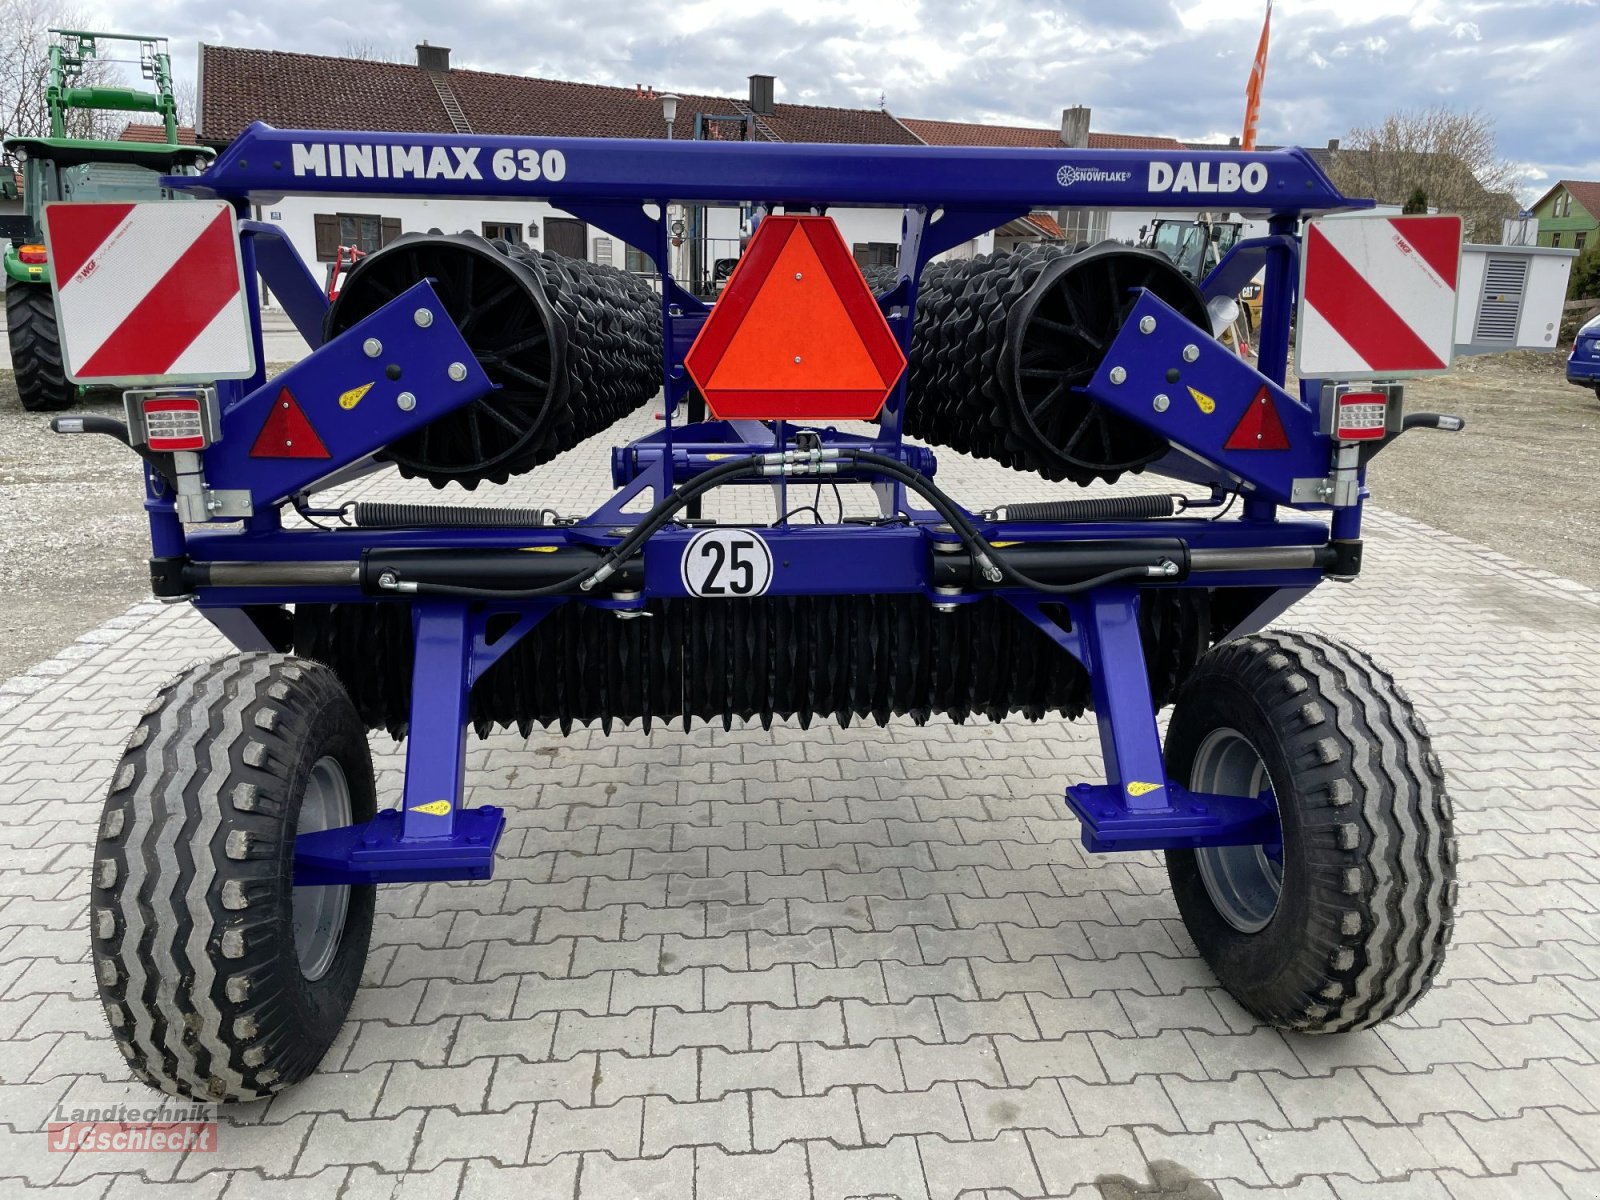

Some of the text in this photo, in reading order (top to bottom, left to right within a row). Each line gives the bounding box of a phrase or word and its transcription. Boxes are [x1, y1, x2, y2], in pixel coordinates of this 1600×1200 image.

[291, 143, 567, 182] MINIMAX 630
[1147, 162, 1269, 193] DALBO
[1242, 286, 1254, 298] CAT
[701, 540, 754, 595] 25
